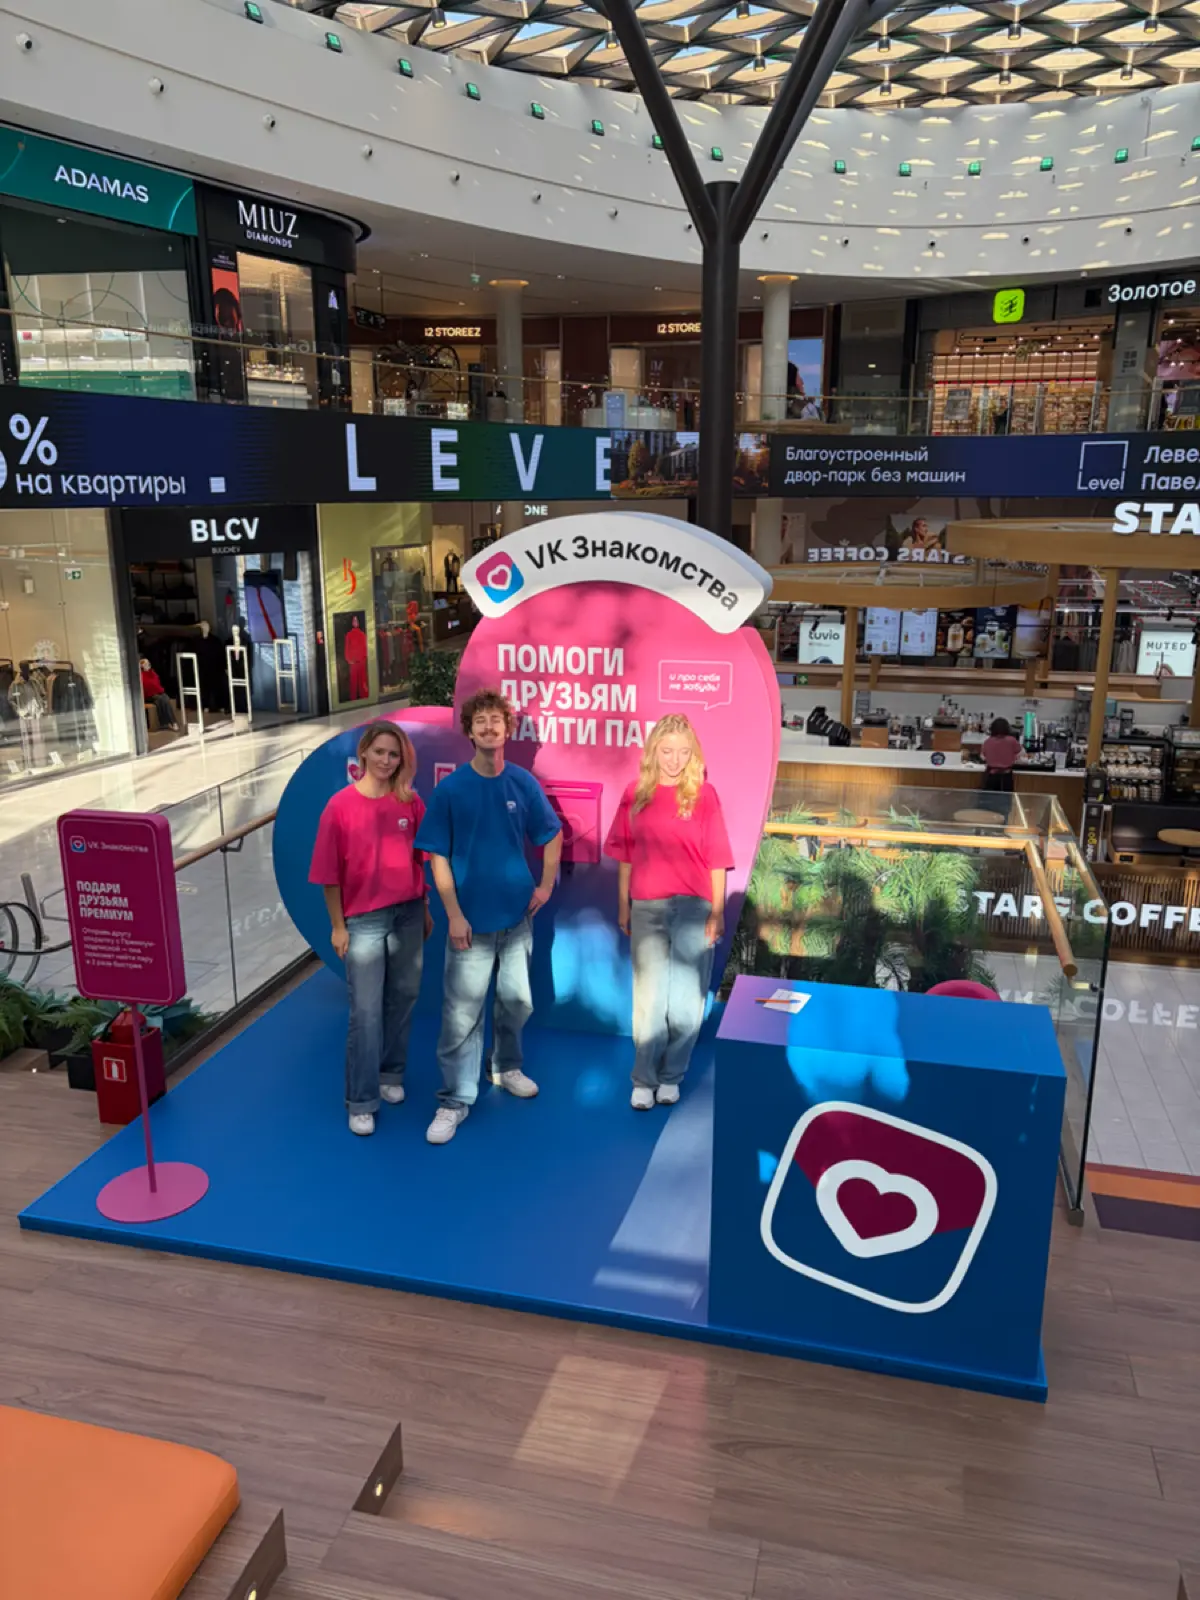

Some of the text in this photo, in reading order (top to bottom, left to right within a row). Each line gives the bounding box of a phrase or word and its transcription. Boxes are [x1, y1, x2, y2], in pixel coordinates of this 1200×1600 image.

[54, 164, 149, 204] ADAMAS
[237, 199, 299, 238] MIUZ
[246, 230, 293, 248] DIAMONDS
[1107, 279, 1197, 303] Золотое
[435, 326, 481, 337] STOREEZ
[785, 446, 929, 465] Благоустроенный
[1143, 445, 1200, 464] Леве
[784, 467, 966, 486] двор-парк без машин
[1077, 470, 1126, 490] Level
[15, 473, 186, 502] на квартиры
[190, 517, 259, 543] BLCV
[525, 535, 740, 612] VK Знакомства
[808, 629, 840, 641] tuvio
[1146, 640, 1188, 652] MUTED
[497, 643, 624, 677] ПОМОГИ
[501, 679, 637, 713] ДРУЗЬЯМ
[76, 880, 121, 894] ПОДАРИ
[78, 894, 129, 908] ДРУЗЬЯМ
[79, 907, 134, 921] ПРЕМИУМ
